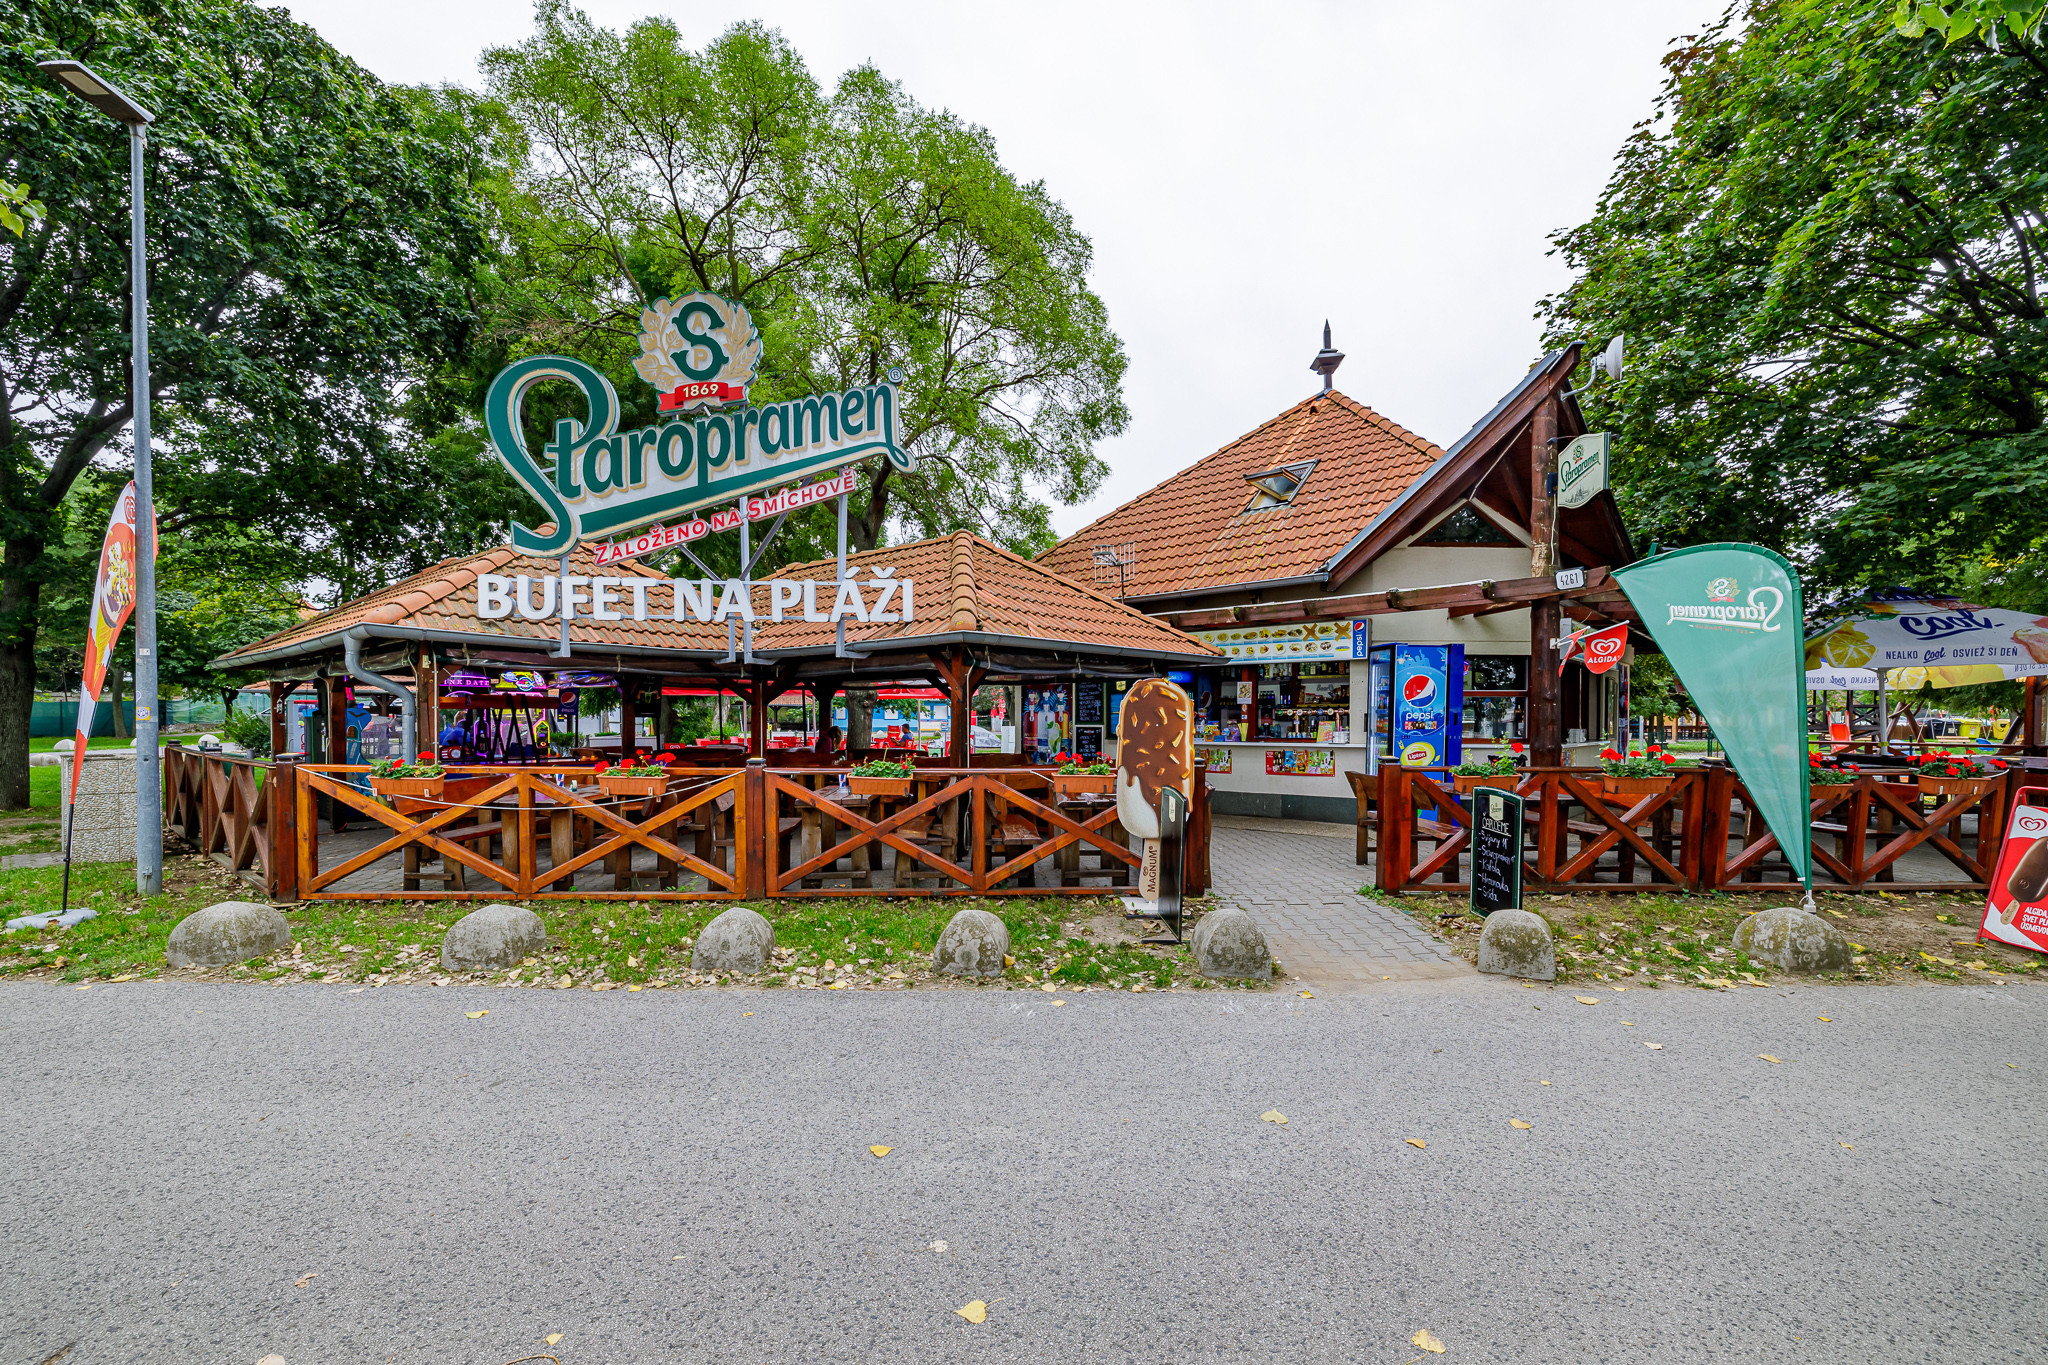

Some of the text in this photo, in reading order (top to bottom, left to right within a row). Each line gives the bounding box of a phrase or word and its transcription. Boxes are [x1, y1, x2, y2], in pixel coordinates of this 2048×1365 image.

[682, 383, 719, 398] 1869
[486, 355, 916, 558] Staropramen
[1560, 450, 1601, 492] Staropramen
[595, 468, 856, 565] ZALOŽENO NA SMÍCHOVĚ
[1560, 572, 1579, 586] 4261
[477, 567, 914, 623] BUFET NA PLÁŽI
[1356, 634, 1364, 657] pepsi
[1885, 650, 1918, 660] NEALKO
[1953, 646, 1985, 658] OSVIEŽ
[1988, 647, 1997, 657] SI
[2000, 645, 2018, 657] DEŇ
[1587, 655, 1617, 664] ALGIDA
[1405, 711, 1434, 720] pepsi
[1408, 751, 1426, 760] Lipton
[1146, 849, 1158, 893] MAGNUM
[2022, 913, 2039, 924] SVET
[2019, 921, 2048, 936] ÚSMEVO
